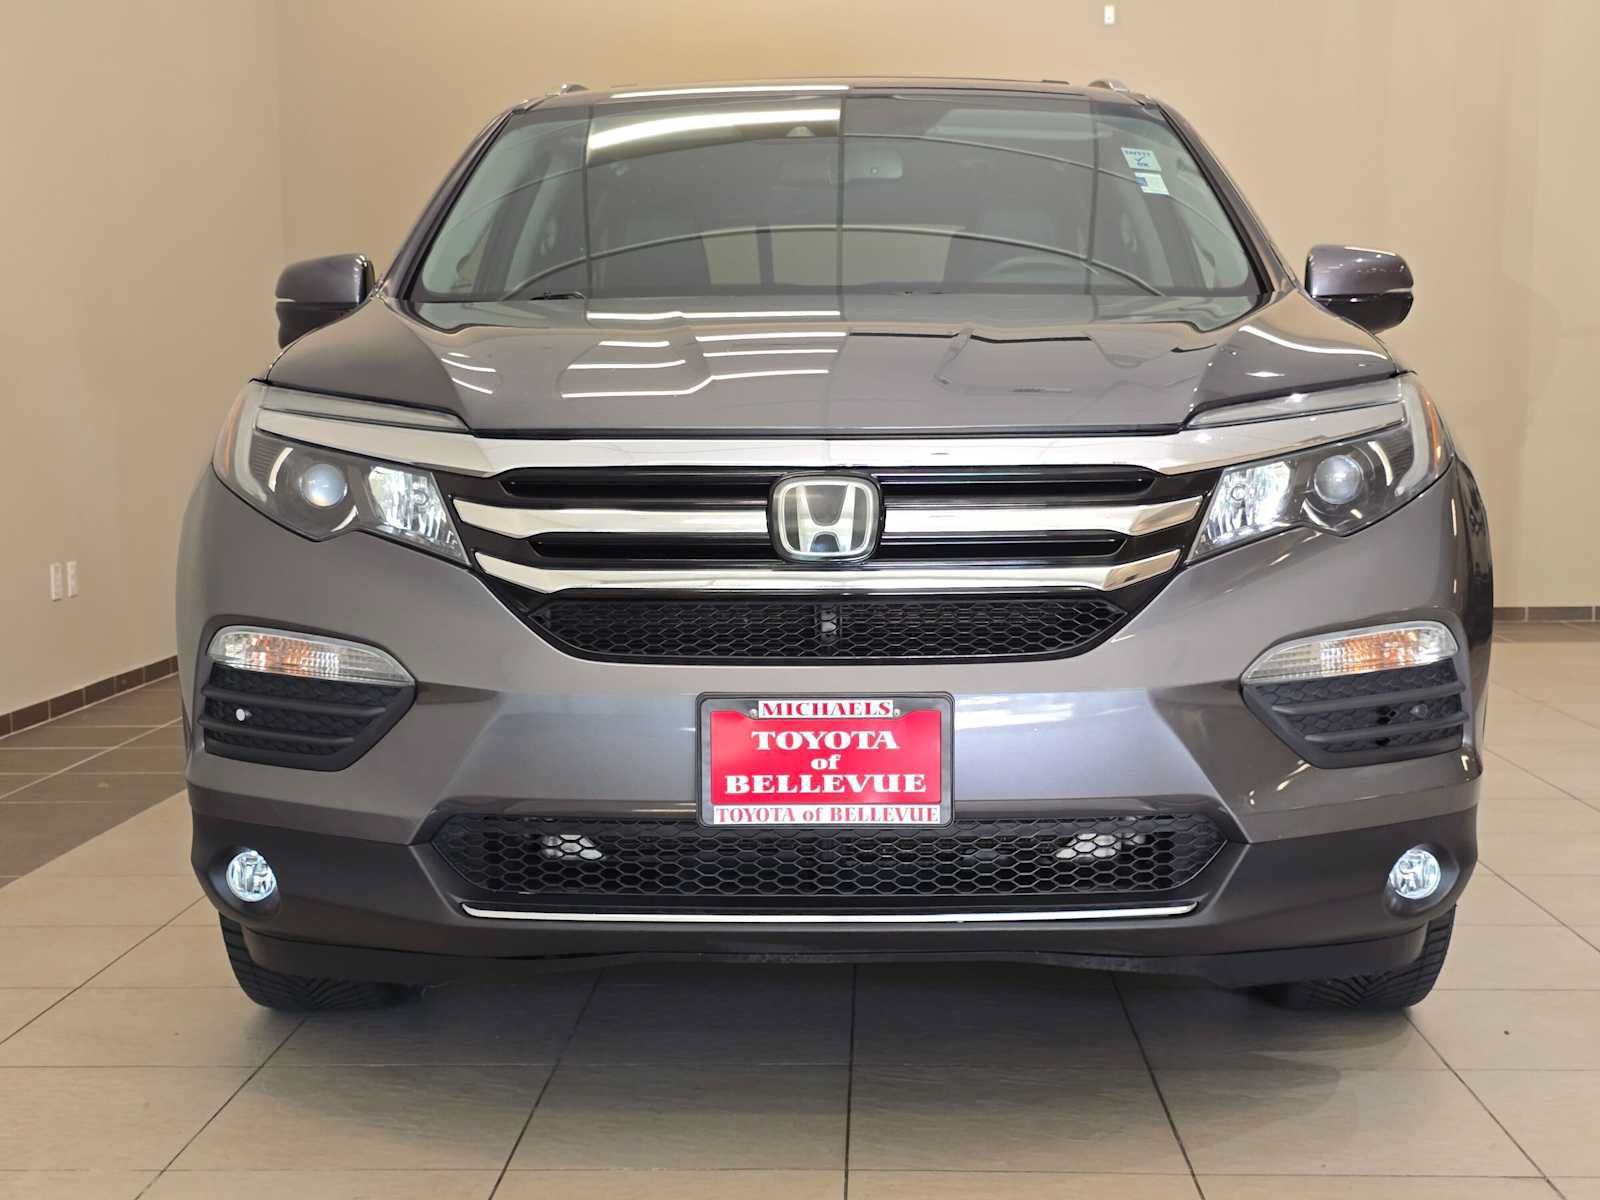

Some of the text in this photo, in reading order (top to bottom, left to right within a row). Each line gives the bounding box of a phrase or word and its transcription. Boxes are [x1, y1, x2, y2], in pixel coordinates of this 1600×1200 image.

[762, 702, 892, 716] MICHAELS
[751, 731, 899, 750] TOYOTA
[810, 754, 841, 770] of
[724, 774, 926, 794] BELLEVUE
[715, 806, 939, 823] TOYOTA of BELLEVUE
